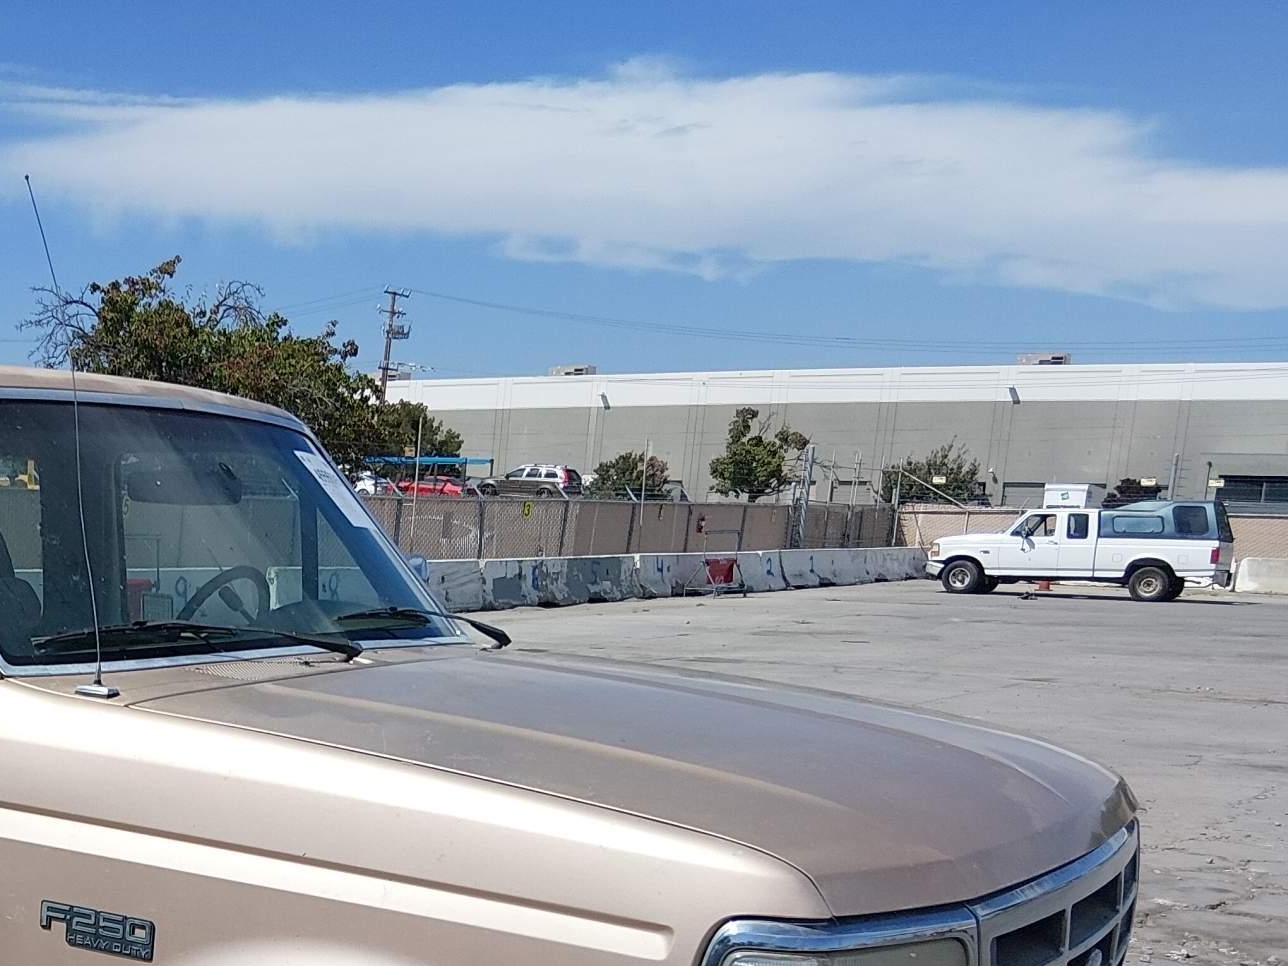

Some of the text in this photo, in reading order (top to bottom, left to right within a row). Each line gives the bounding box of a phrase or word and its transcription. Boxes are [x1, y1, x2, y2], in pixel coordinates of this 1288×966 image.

[655, 556, 664, 578] 4
[766, 557, 775, 577] 2
[67, 933, 152, 959] HEAVY DUTY
